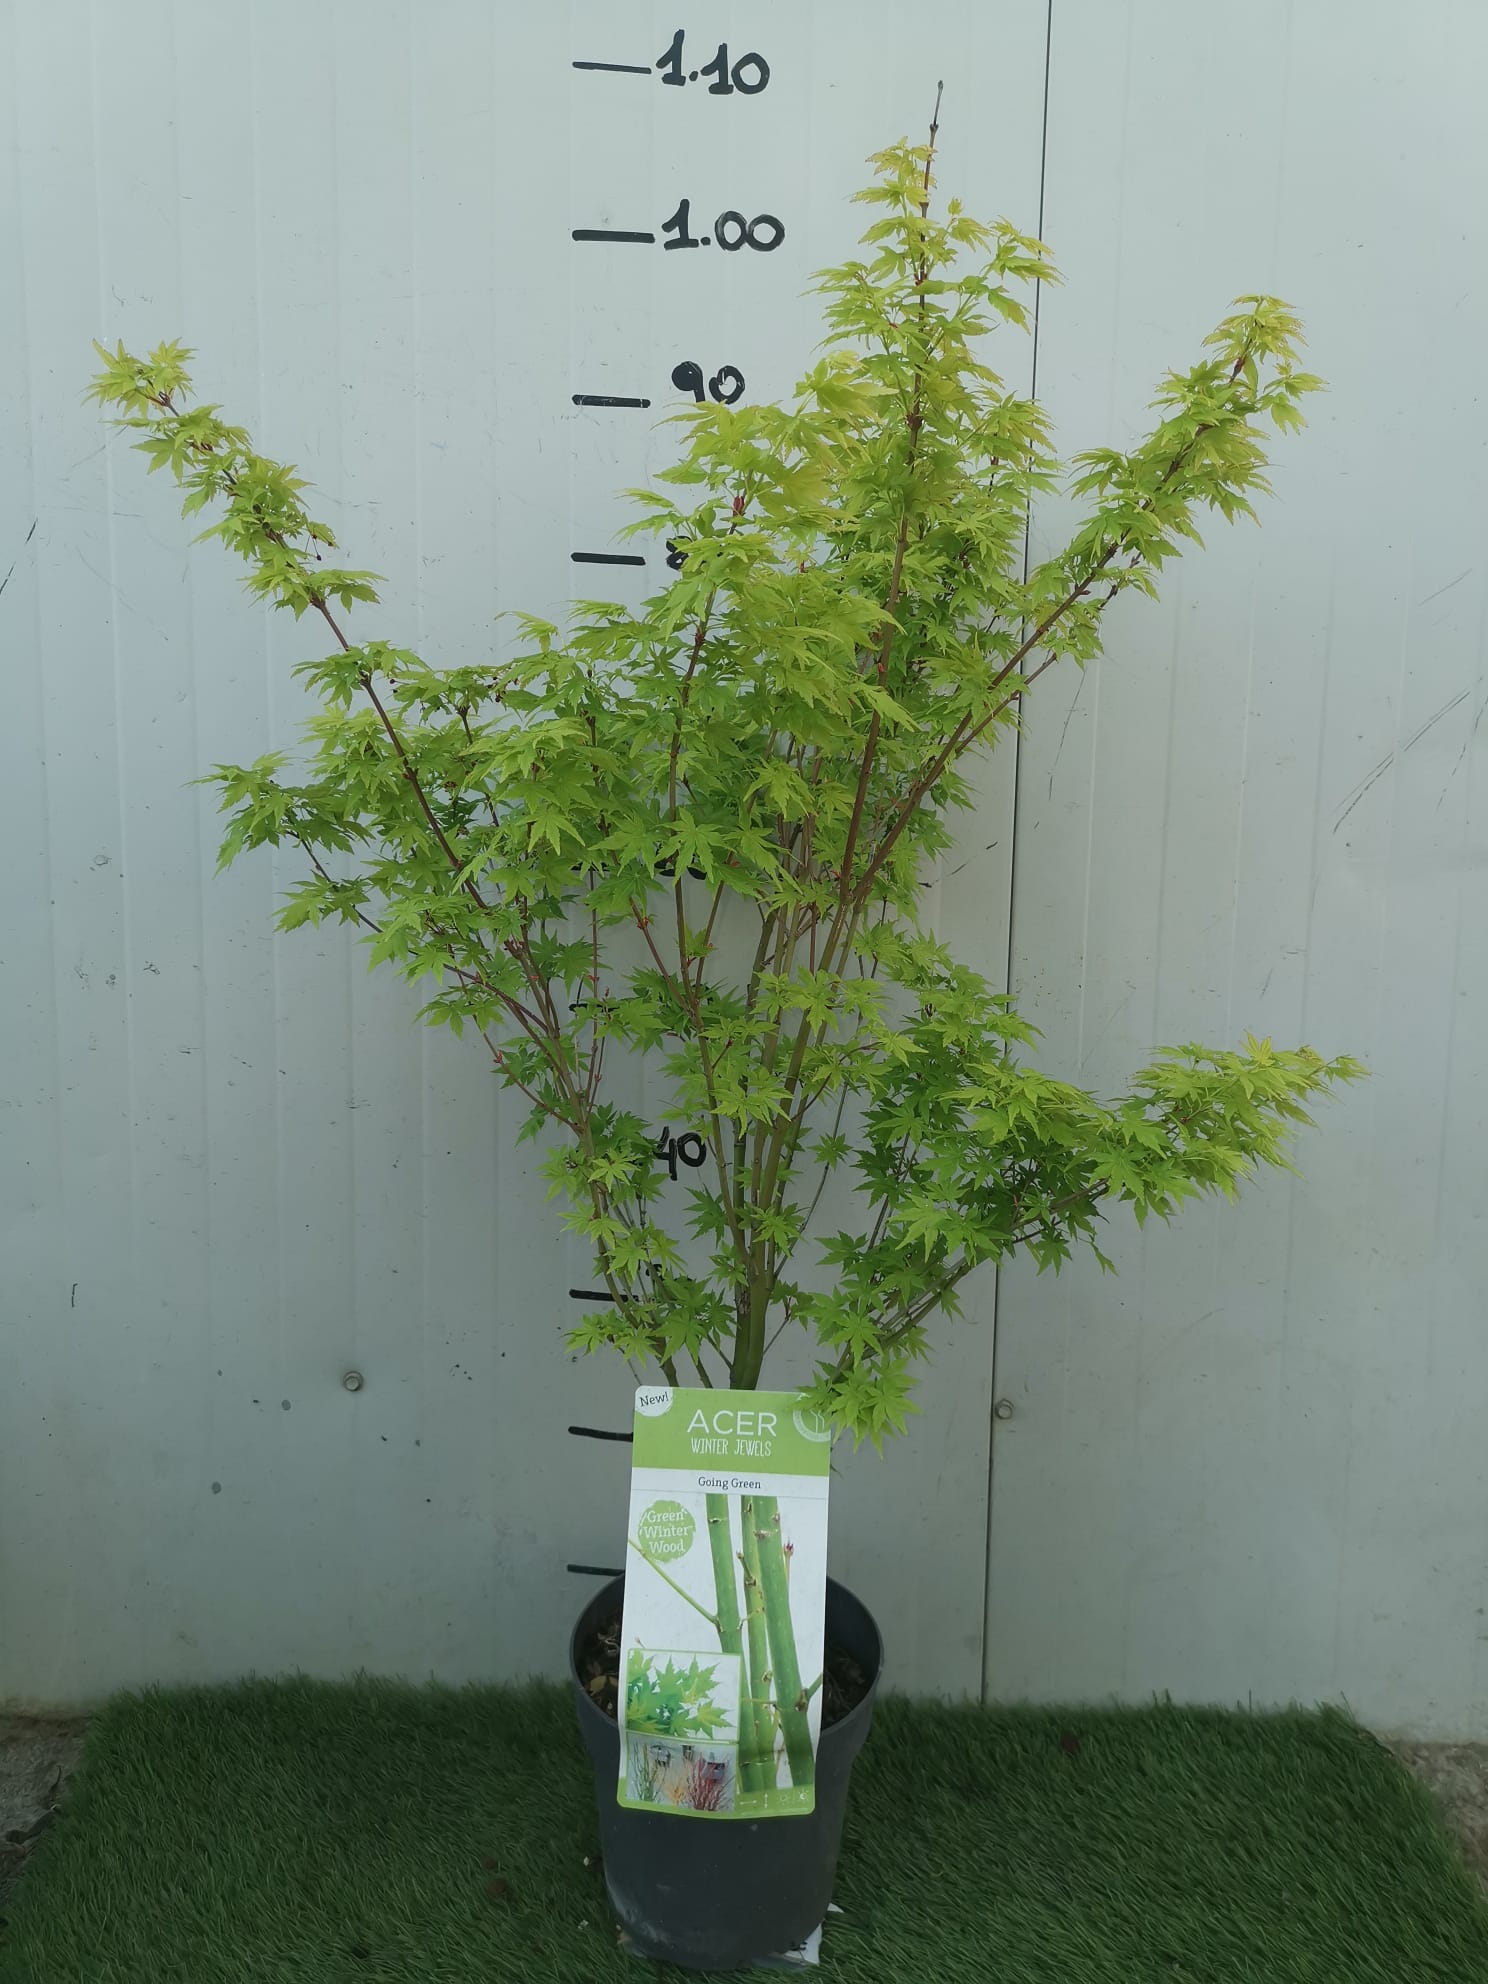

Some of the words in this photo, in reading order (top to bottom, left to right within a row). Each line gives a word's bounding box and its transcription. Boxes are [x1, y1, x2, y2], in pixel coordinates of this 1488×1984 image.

[656, 29, 770, 95] 1.10
[661, 199, 785, 251] 1.00
[672, 361, 746, 405] 90
[654, 1126, 707, 1181] 40
[639, 1392, 670, 1408] New!
[687, 1409, 777, 1437] ACER
[691, 1438, 729, 1456] WINTER
[734, 1439, 772, 1457] JEWELS
[698, 1477, 729, 1490] Going
[731, 1478, 762, 1490] Green
[646, 1510, 685, 1524] Green
[643, 1525, 690, 1539] Winter
[649, 1540, 685, 1553] Wood
